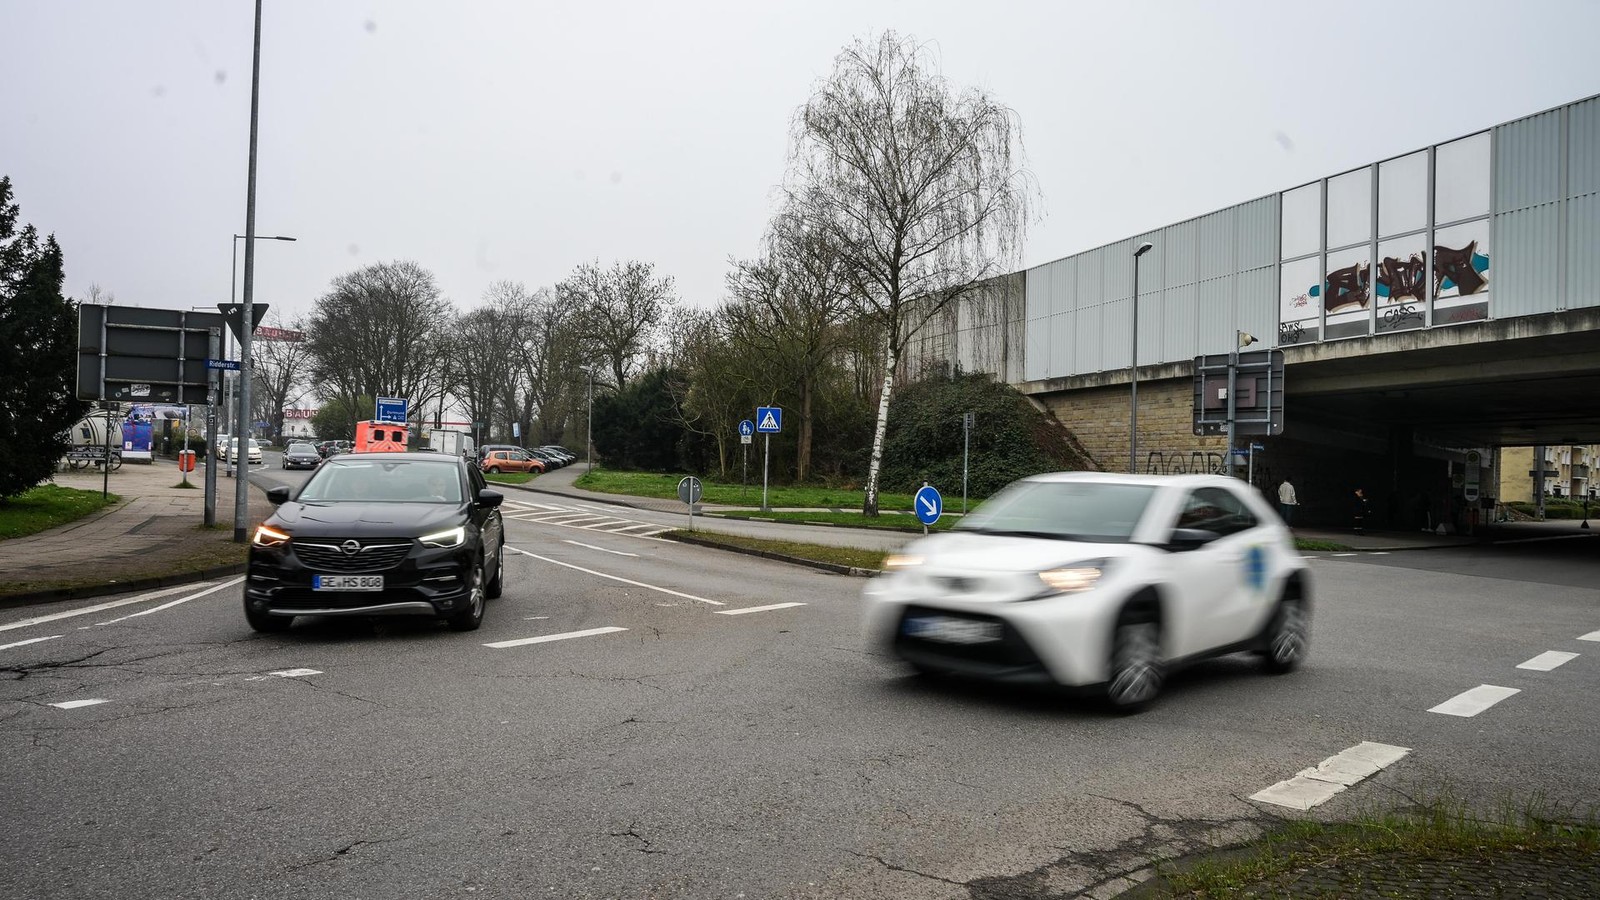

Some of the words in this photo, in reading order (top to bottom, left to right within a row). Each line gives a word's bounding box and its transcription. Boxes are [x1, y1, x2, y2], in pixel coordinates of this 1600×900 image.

[209, 360, 236, 369] Ridderstr.
[320, 577, 336, 587] GE
[342, 577, 358, 587] HS
